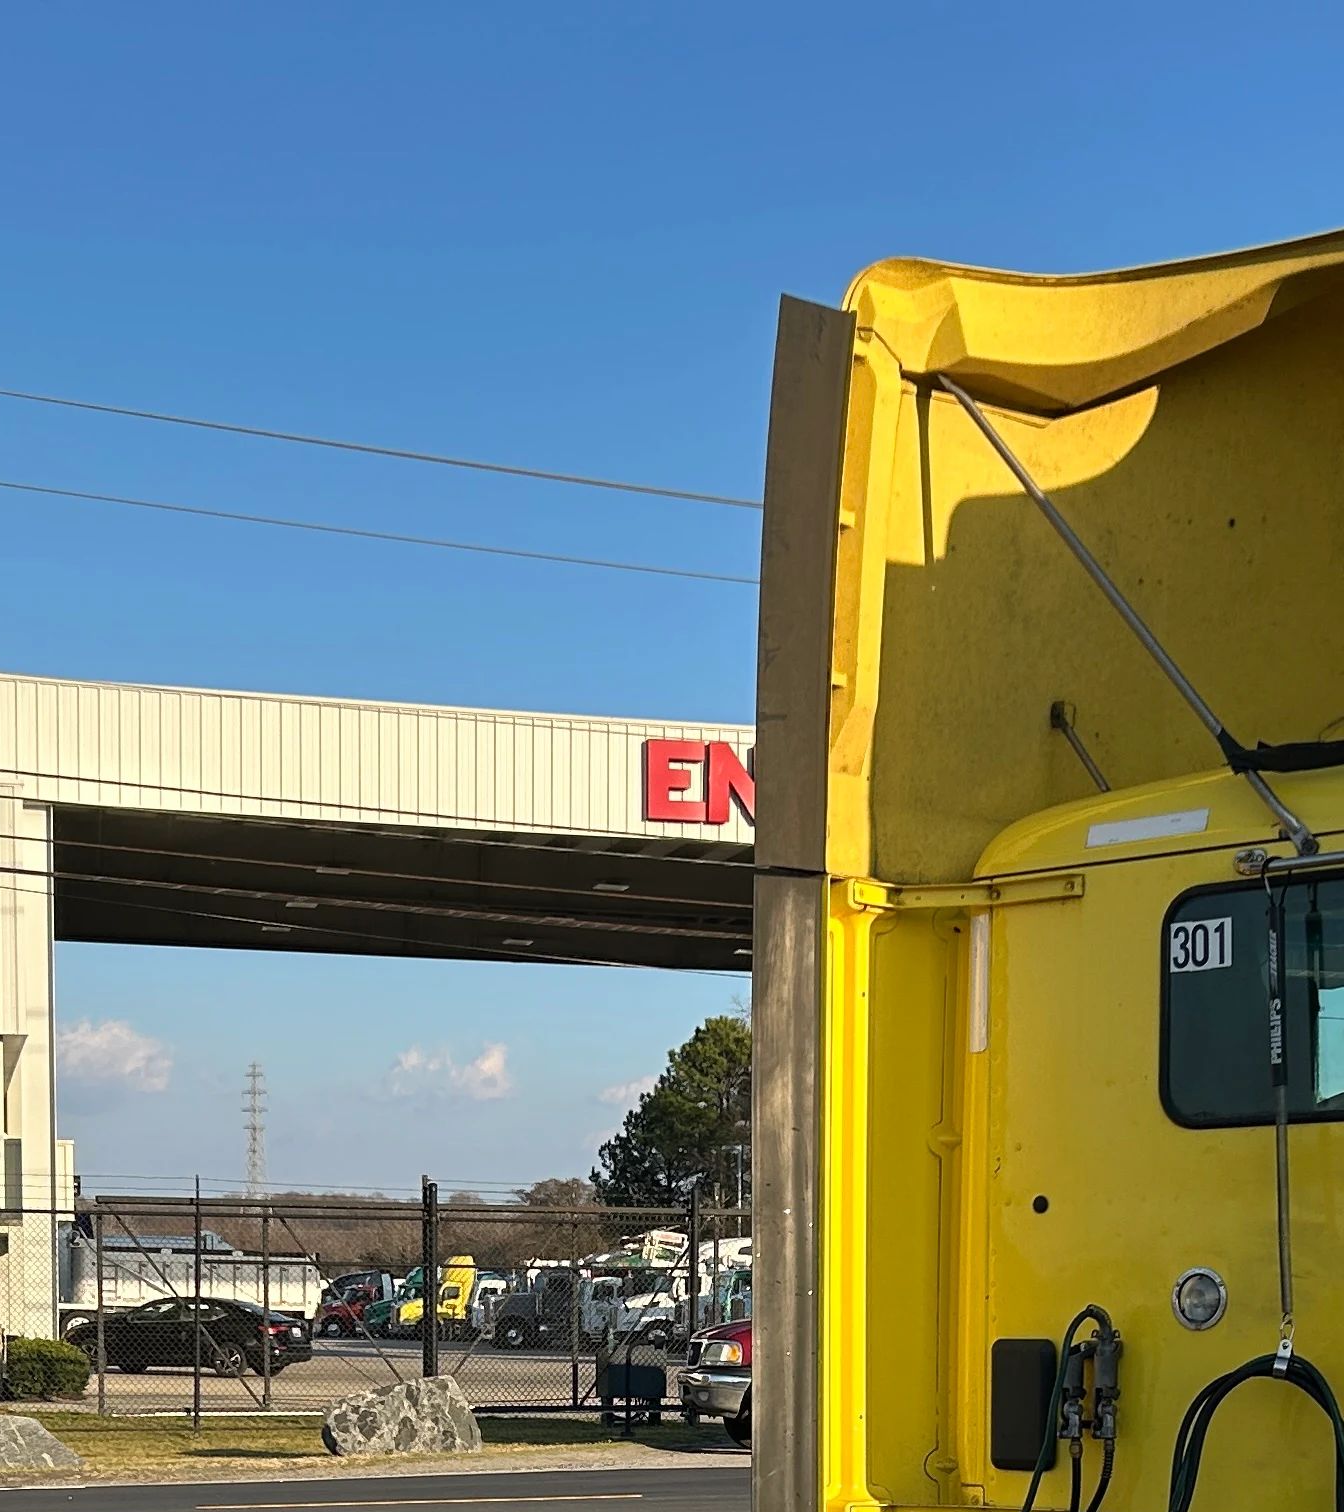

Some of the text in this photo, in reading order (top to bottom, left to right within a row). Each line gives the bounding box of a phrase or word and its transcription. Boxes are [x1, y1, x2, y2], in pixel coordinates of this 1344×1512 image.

[643, 738, 756, 826] EN
[1172, 921, 1225, 969] 301
[1269, 997, 1283, 1065] PHILLIPS
